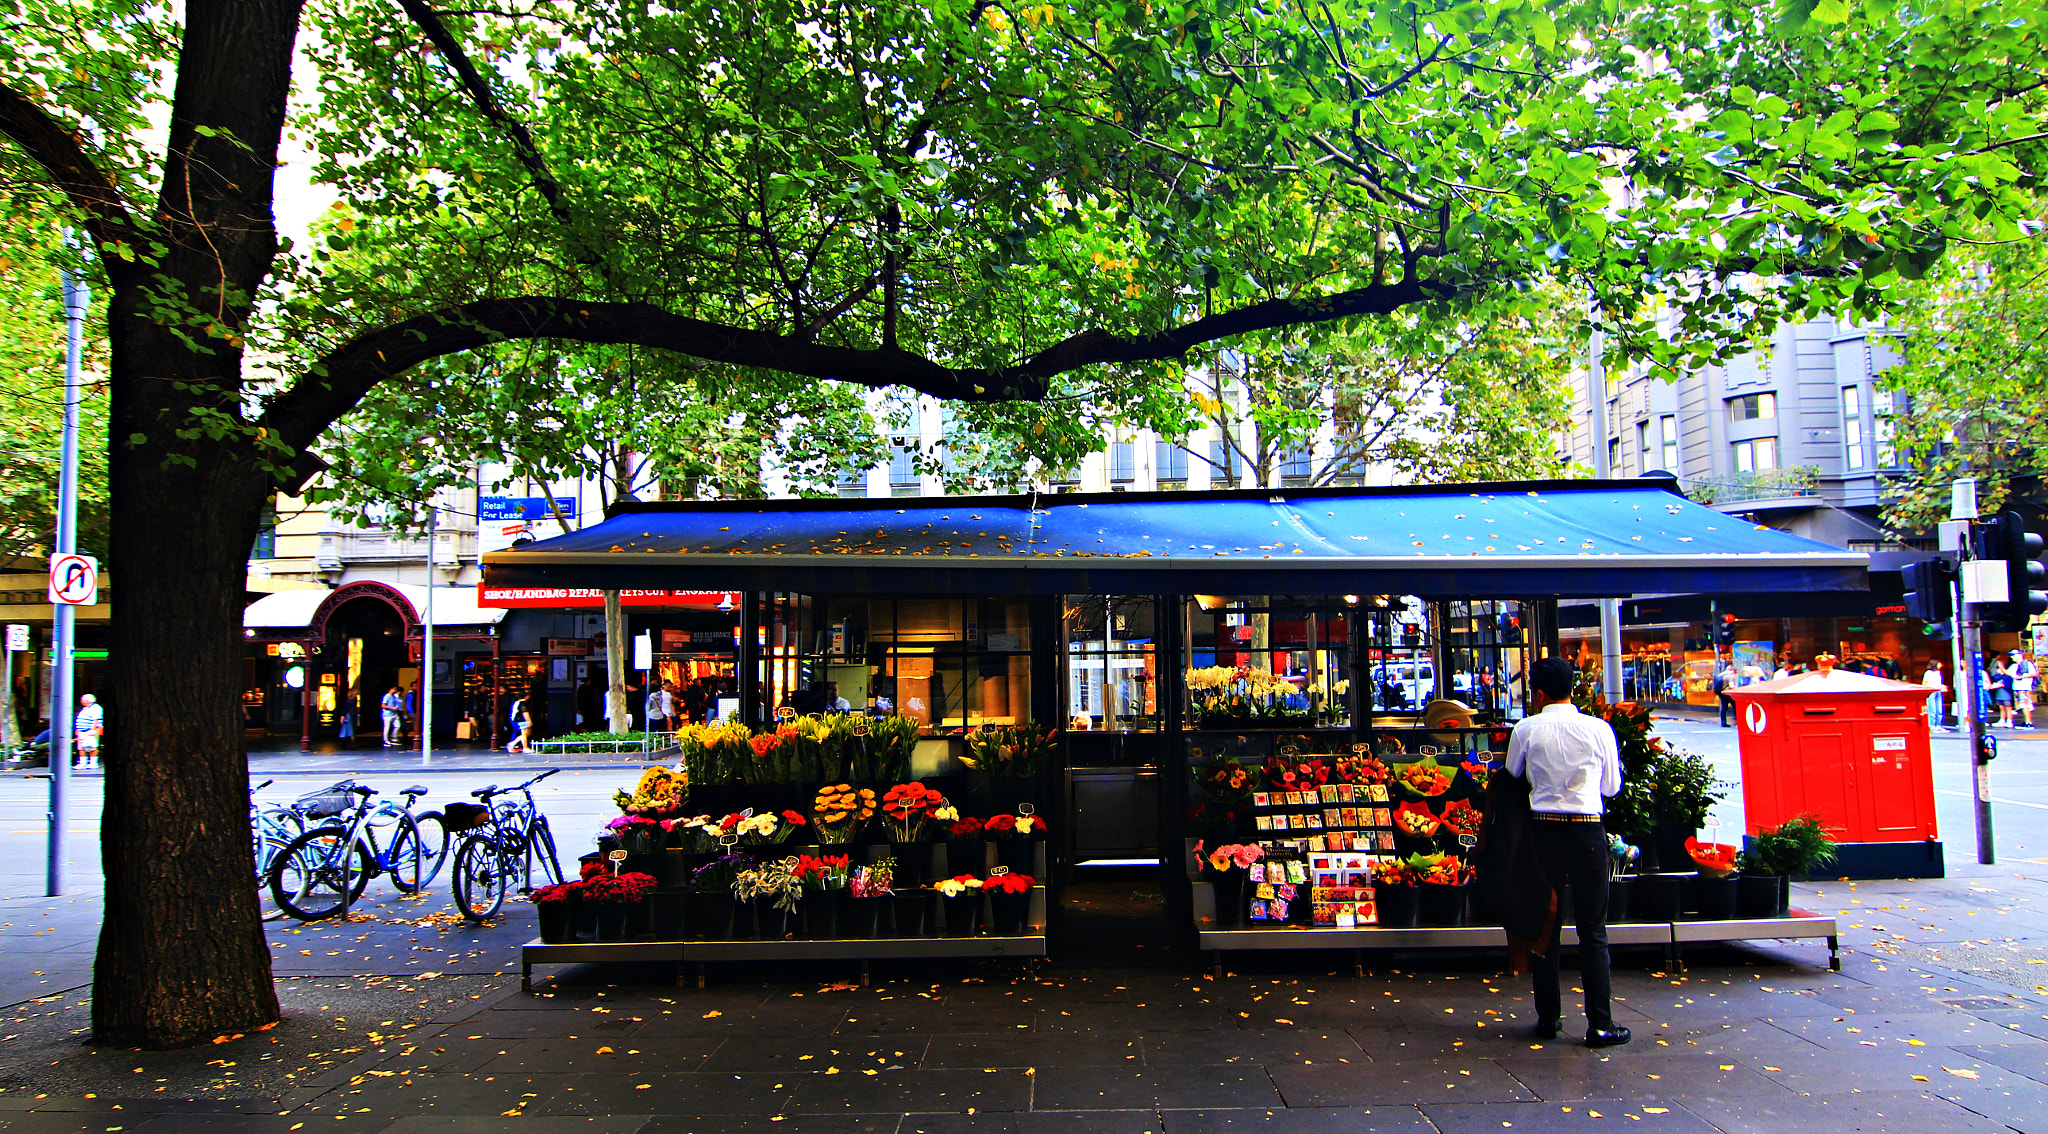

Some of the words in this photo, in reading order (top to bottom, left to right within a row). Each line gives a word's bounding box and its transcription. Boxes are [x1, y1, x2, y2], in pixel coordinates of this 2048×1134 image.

[483, 501, 506, 510] Retail
[482, 511, 497, 519] For
[499, 511, 523, 519] Lease
[484, 589, 567, 600] SHOE/HANDBAG
[568, 588, 604, 598] REPAI
[1875, 605, 1907, 616] gorman
